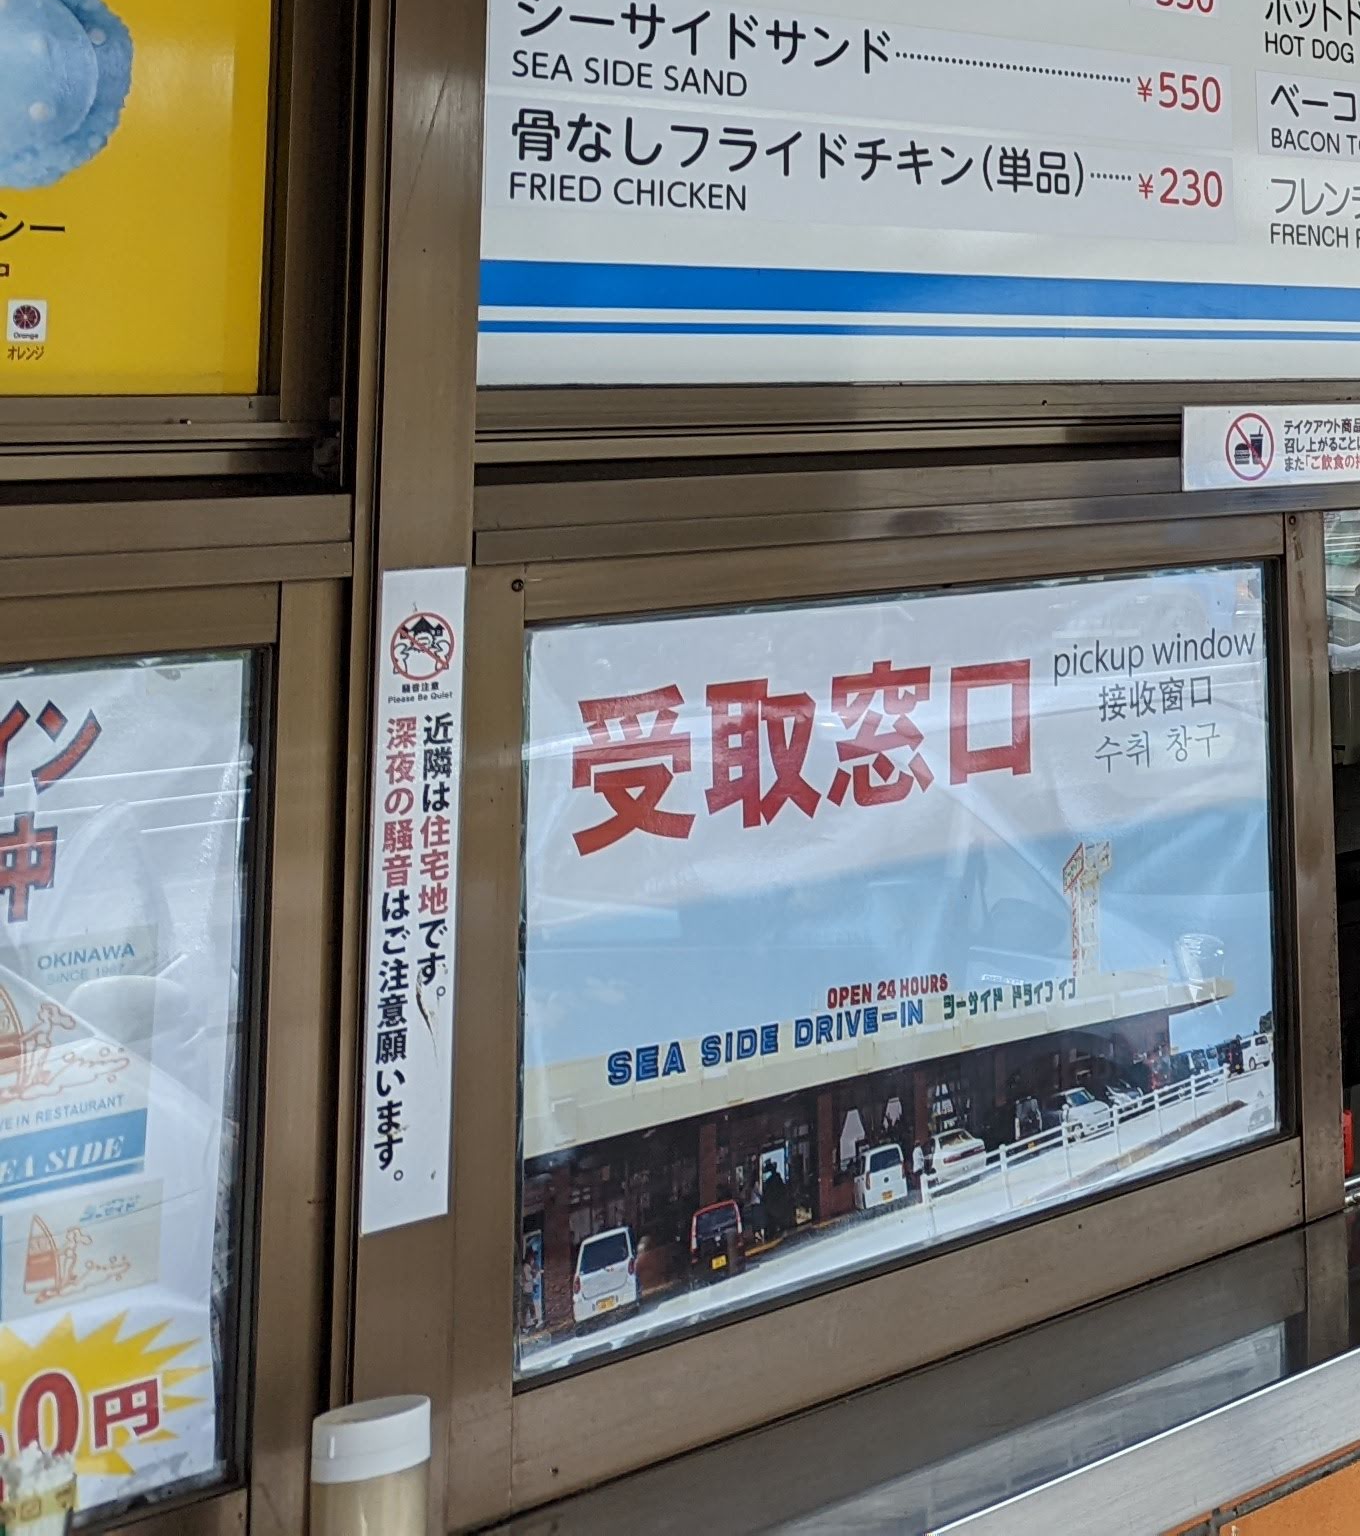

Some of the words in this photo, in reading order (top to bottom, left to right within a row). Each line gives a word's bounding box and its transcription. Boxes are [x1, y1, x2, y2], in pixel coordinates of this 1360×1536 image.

[1264, 30, 1306, 59] HOT
[1311, 36, 1356, 65] DOG
[510, 49, 574, 84] SEA
[583, 56, 654, 91] SIDE
[662, 64, 749, 99] SAND
[1135, 69, 1223, 115] ¥550
[510, 106, 1084, 199] 骨なしフライドチキン(単品)
[1136, 163, 1224, 210] ¥230
[1271, 126, 1342, 158] BACON
[507, 171, 603, 206] FRIED
[612, 176, 748, 213] CHICKEN
[1270, 222, 1351, 252] FRENCH
[7, 346, 45, 361] オレンジ
[1053, 640, 1145, 687] pickup
[1152, 627, 1257, 666] window
[387, 693, 413, 704] Please
[415, 693, 427, 703] Be
[428, 690, 454, 703] Quiet
[1098, 675, 1213, 723] 接收窗口
[570, 657, 1033, 858] 受取窓口
[1094, 730, 1151, 774] 수취
[1166, 722, 1221, 763] 창구
[417, 713, 454, 998] 近隣は住宅地です。
[37, 942, 135, 971] OKINAWA
[373, 716, 418, 1183] 深夜の騒音はご注意願います。
[827, 982, 873, 1009] OPEN
[876, 979, 897, 1001] 24
[899, 972, 949, 999] HOURS
[607, 1043, 686, 1087] SEA
[701, 1023, 779, 1067] SIDE
[794, 999, 925, 1048] DRIVE-IN
[16, 1112, 31, 1127] IN
[35, 1094, 126, 1125] RESTAURANT
[46, 1135, 127, 1173] SIDE
